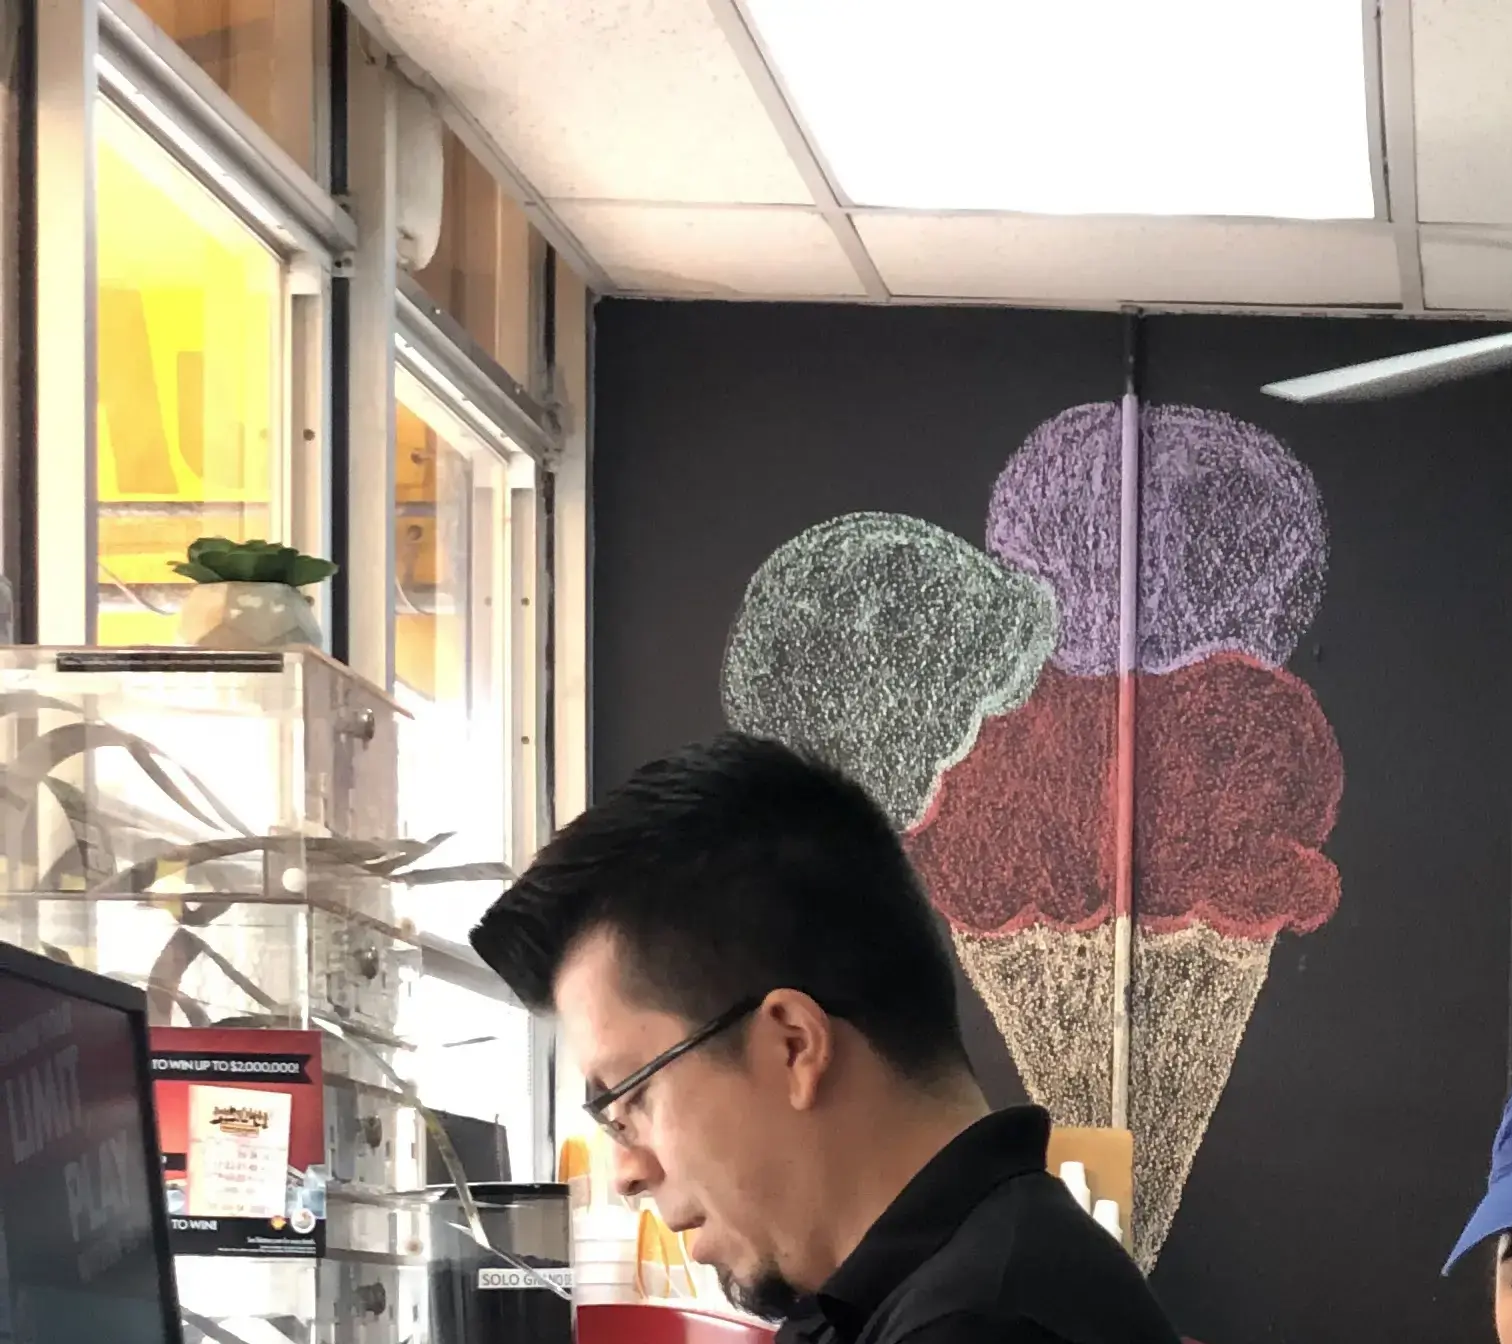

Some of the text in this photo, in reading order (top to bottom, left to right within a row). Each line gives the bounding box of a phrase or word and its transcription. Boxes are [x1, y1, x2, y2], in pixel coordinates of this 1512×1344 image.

[152, 1059, 168, 1070] TO
[169, 1060, 194, 1070] WIN
[195, 1060, 211, 1071] UP
[212, 1061, 229, 1071] TO
[172, 1219, 188, 1230] TO
[482, 1273, 520, 1286] SOLO
